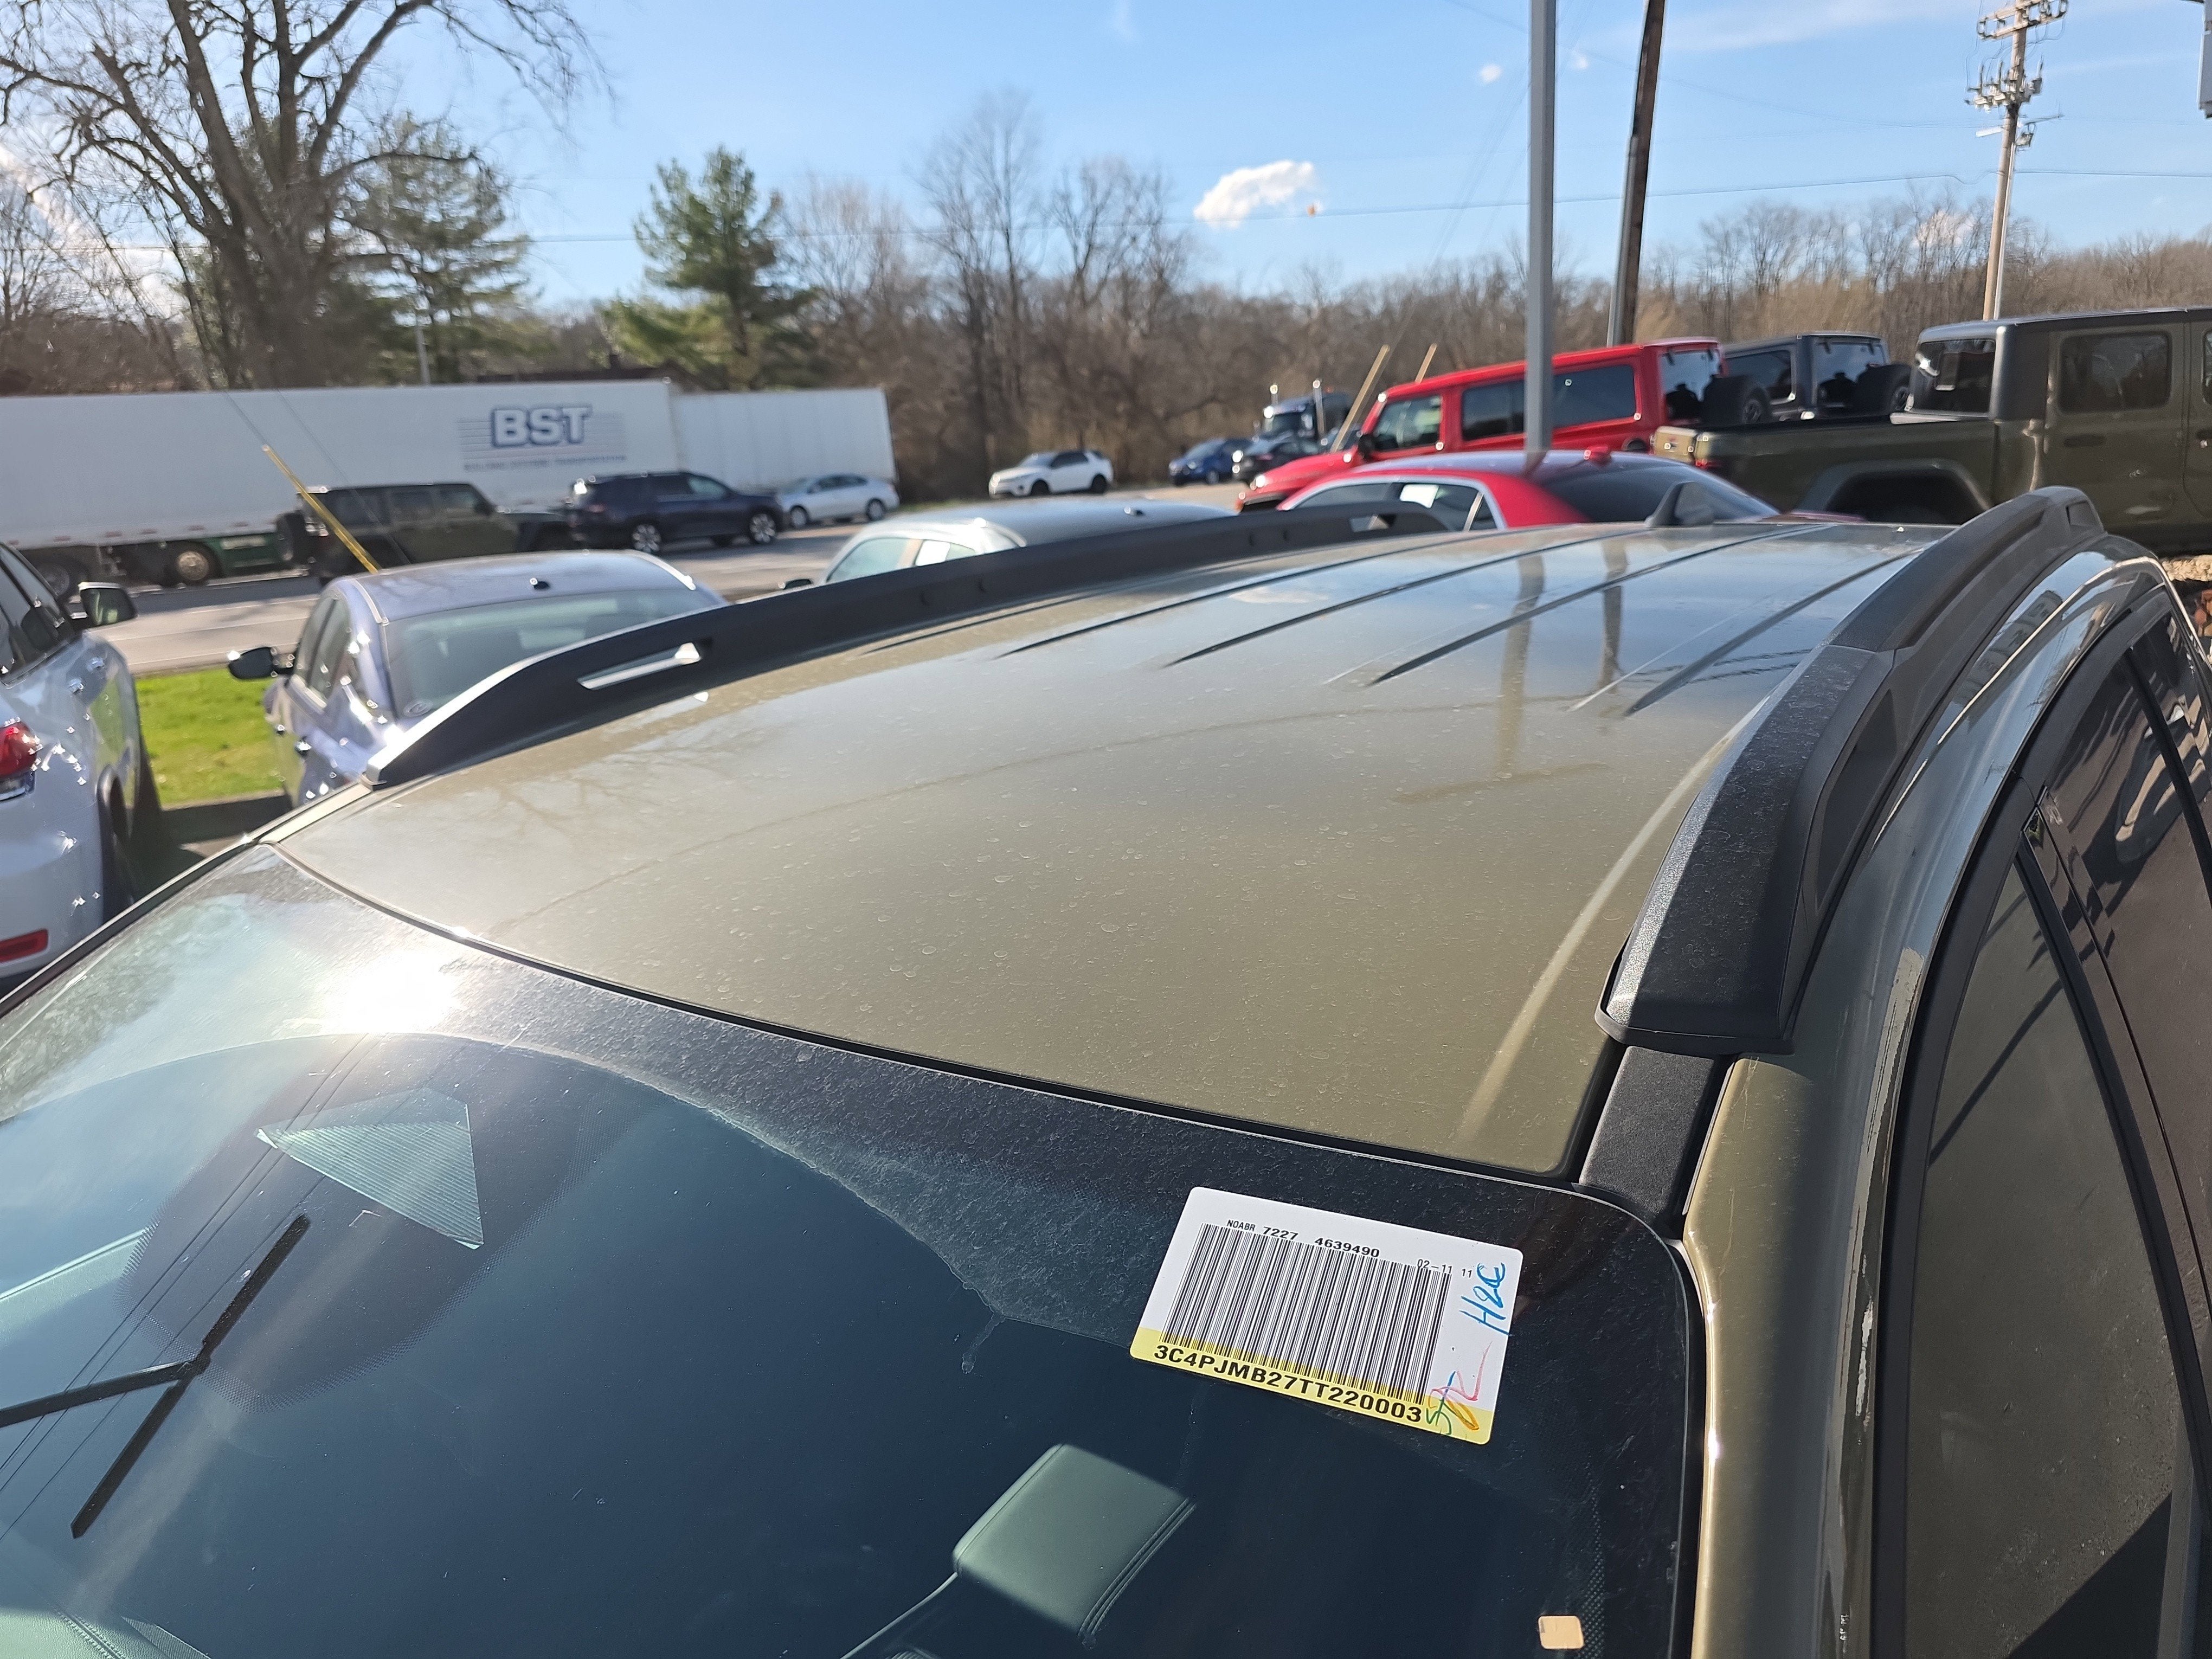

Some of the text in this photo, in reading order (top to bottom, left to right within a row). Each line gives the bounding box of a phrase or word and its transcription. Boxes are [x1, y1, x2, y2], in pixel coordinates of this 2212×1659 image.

[491, 404, 592, 447] BST
[1263, 1226, 1299, 1240] 7227
[1314, 1238, 1380, 1258] 4639490
[1417, 1259, 1452, 1274] 02-11
[1461, 1268, 1472, 1278] 11
[1154, 1345, 1423, 1423] 3C4PJMB27TT220003
